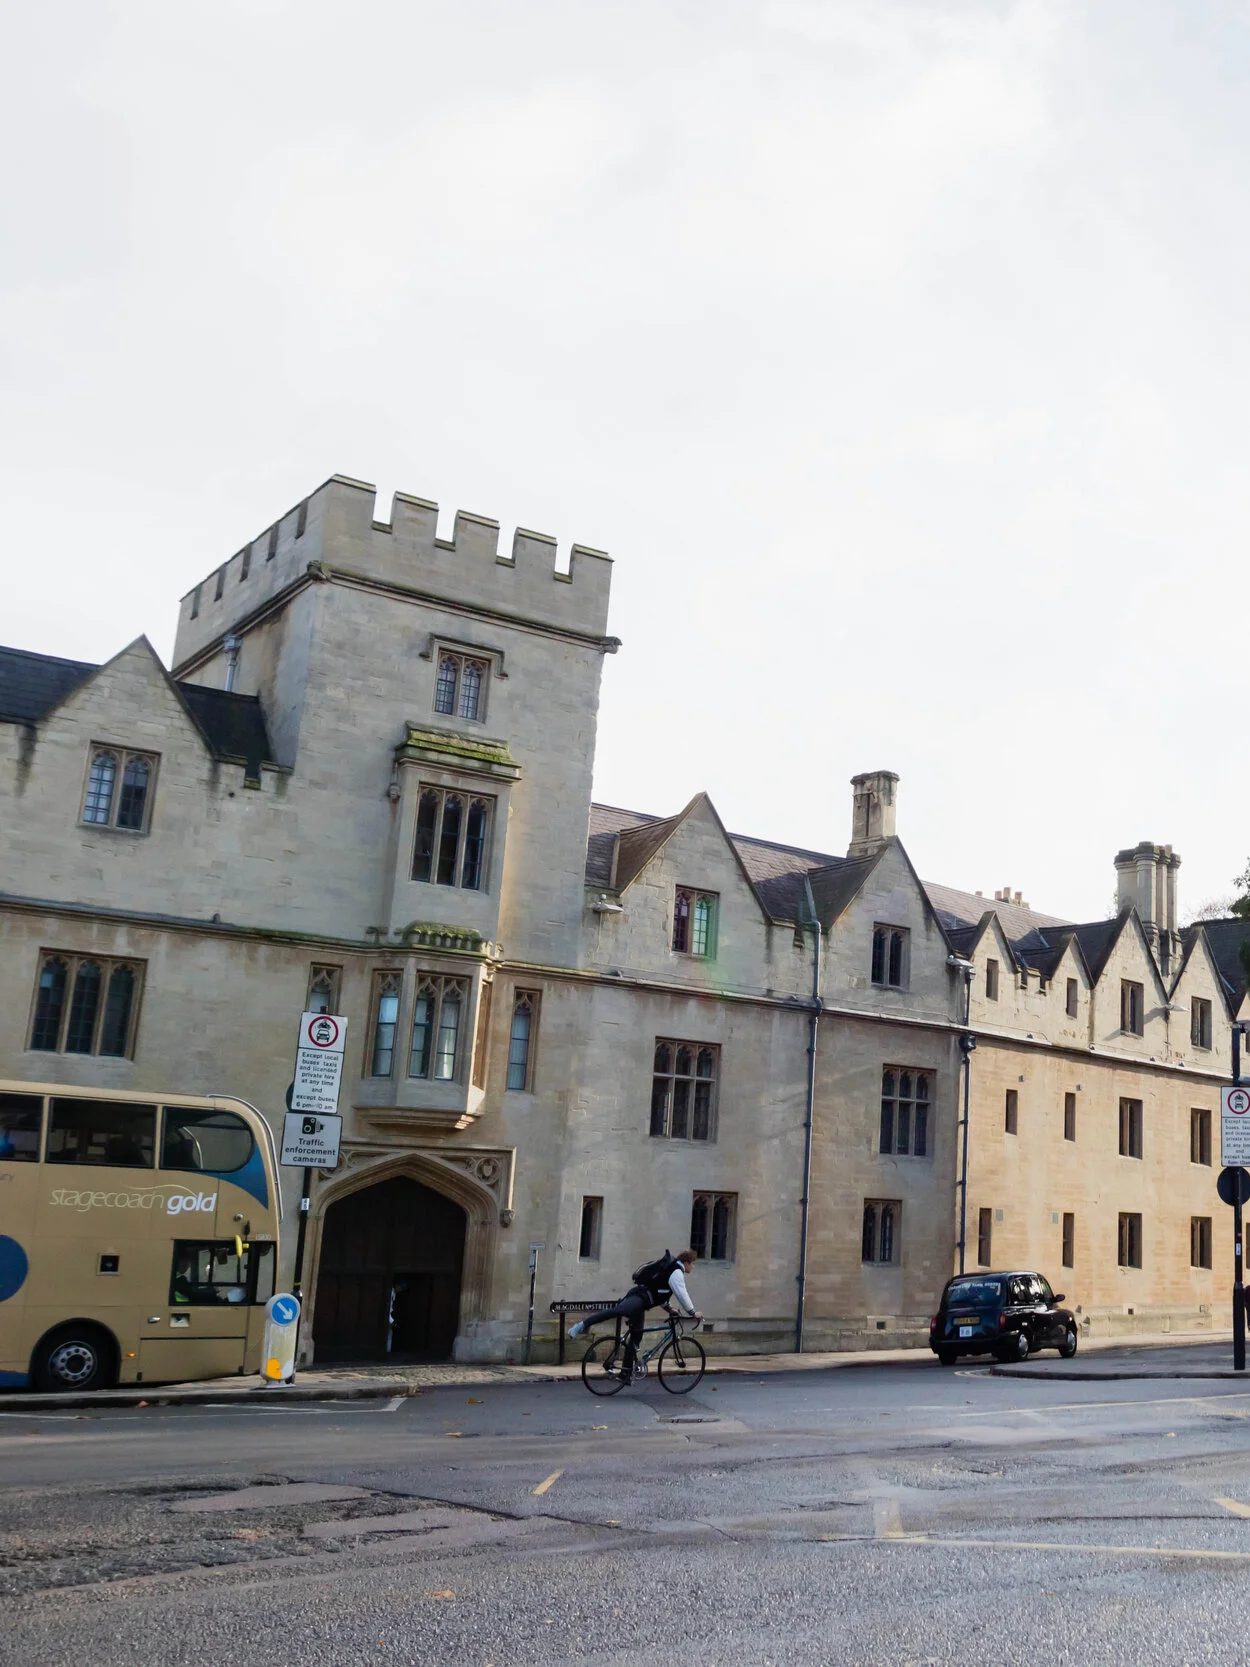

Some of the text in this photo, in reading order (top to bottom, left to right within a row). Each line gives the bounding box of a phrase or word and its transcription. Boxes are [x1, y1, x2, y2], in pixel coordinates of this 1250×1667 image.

[298, 1138, 325, 1146] Traffic
[285, 1146, 336, 1155] enforcement
[292, 1156, 327, 1164] cameras
[50, 1187, 217, 1215] stagecoach gold
